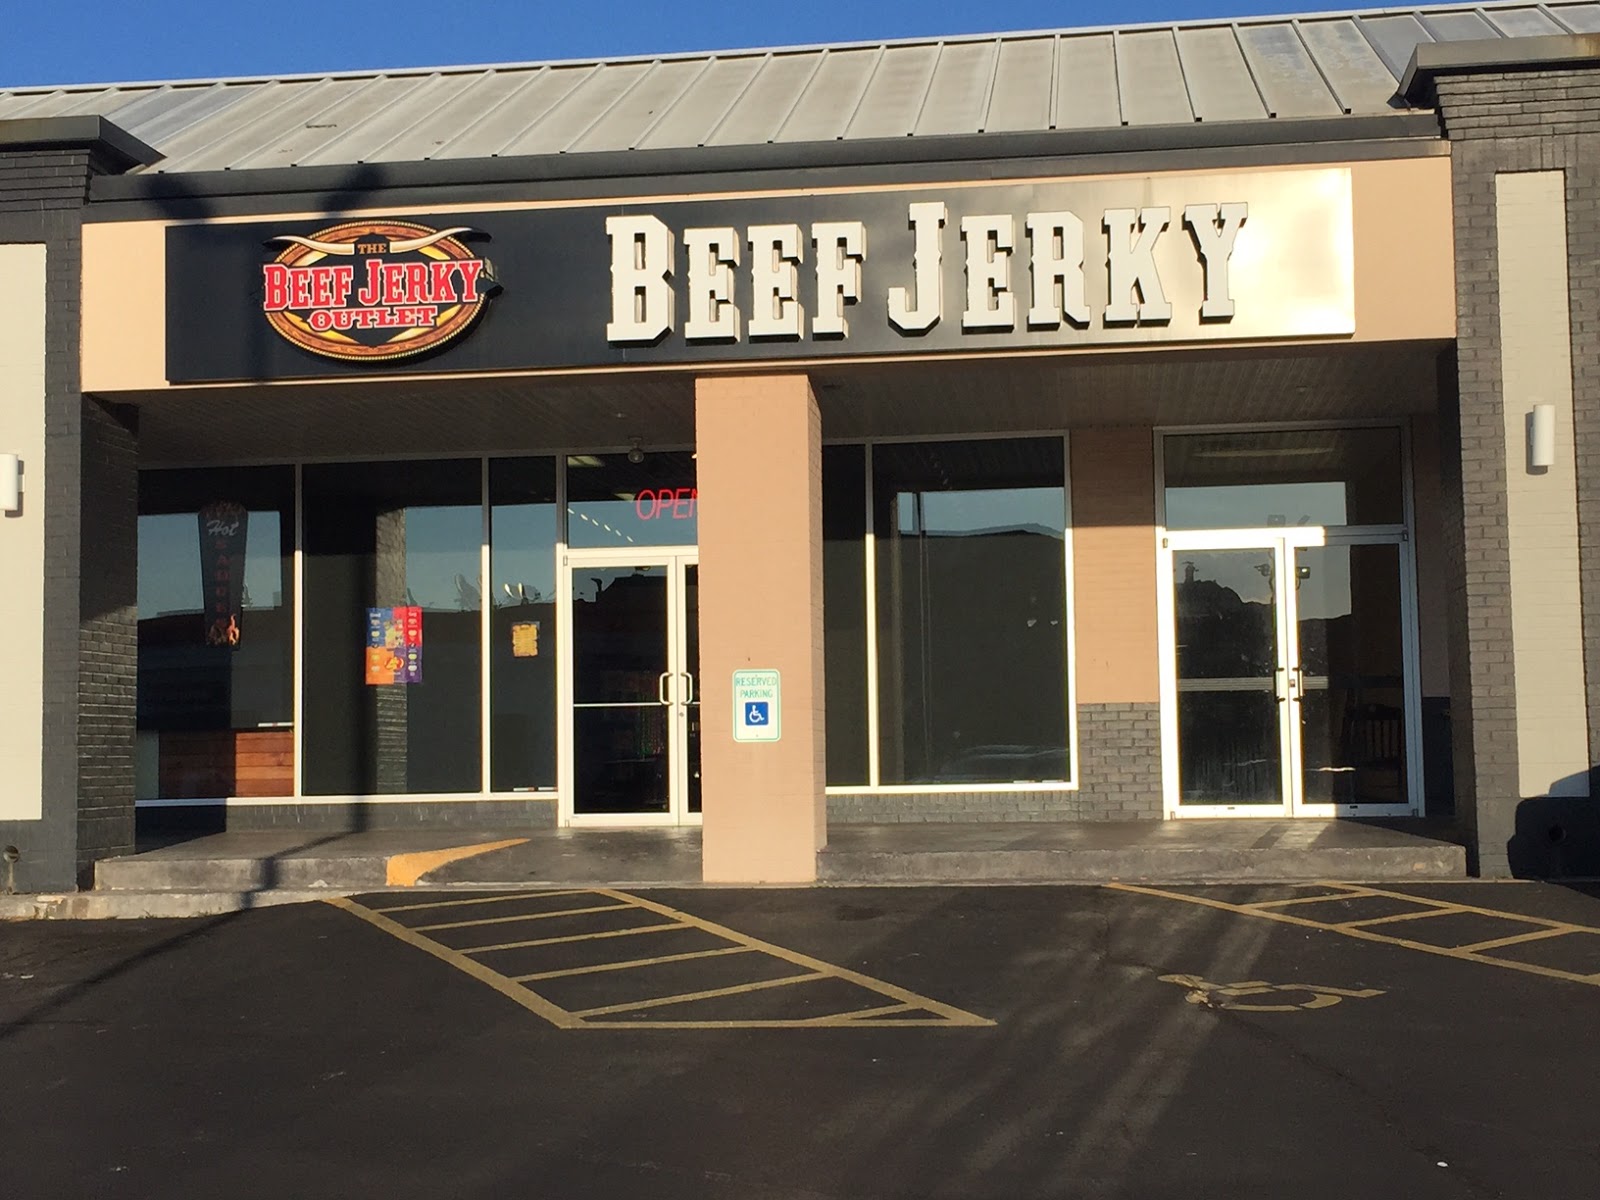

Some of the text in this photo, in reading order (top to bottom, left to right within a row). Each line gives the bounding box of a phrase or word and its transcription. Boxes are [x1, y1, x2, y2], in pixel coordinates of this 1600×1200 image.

[357, 243, 387, 254] THE
[605, 202, 1249, 347] BEEF JERKY
[263, 258, 484, 311] BEEF JERKY
[309, 305, 438, 331] OUTLET
[206, 519, 239, 536] Hot
[735, 676, 777, 686] RESERVED
[740, 689, 773, 698] PARKING
